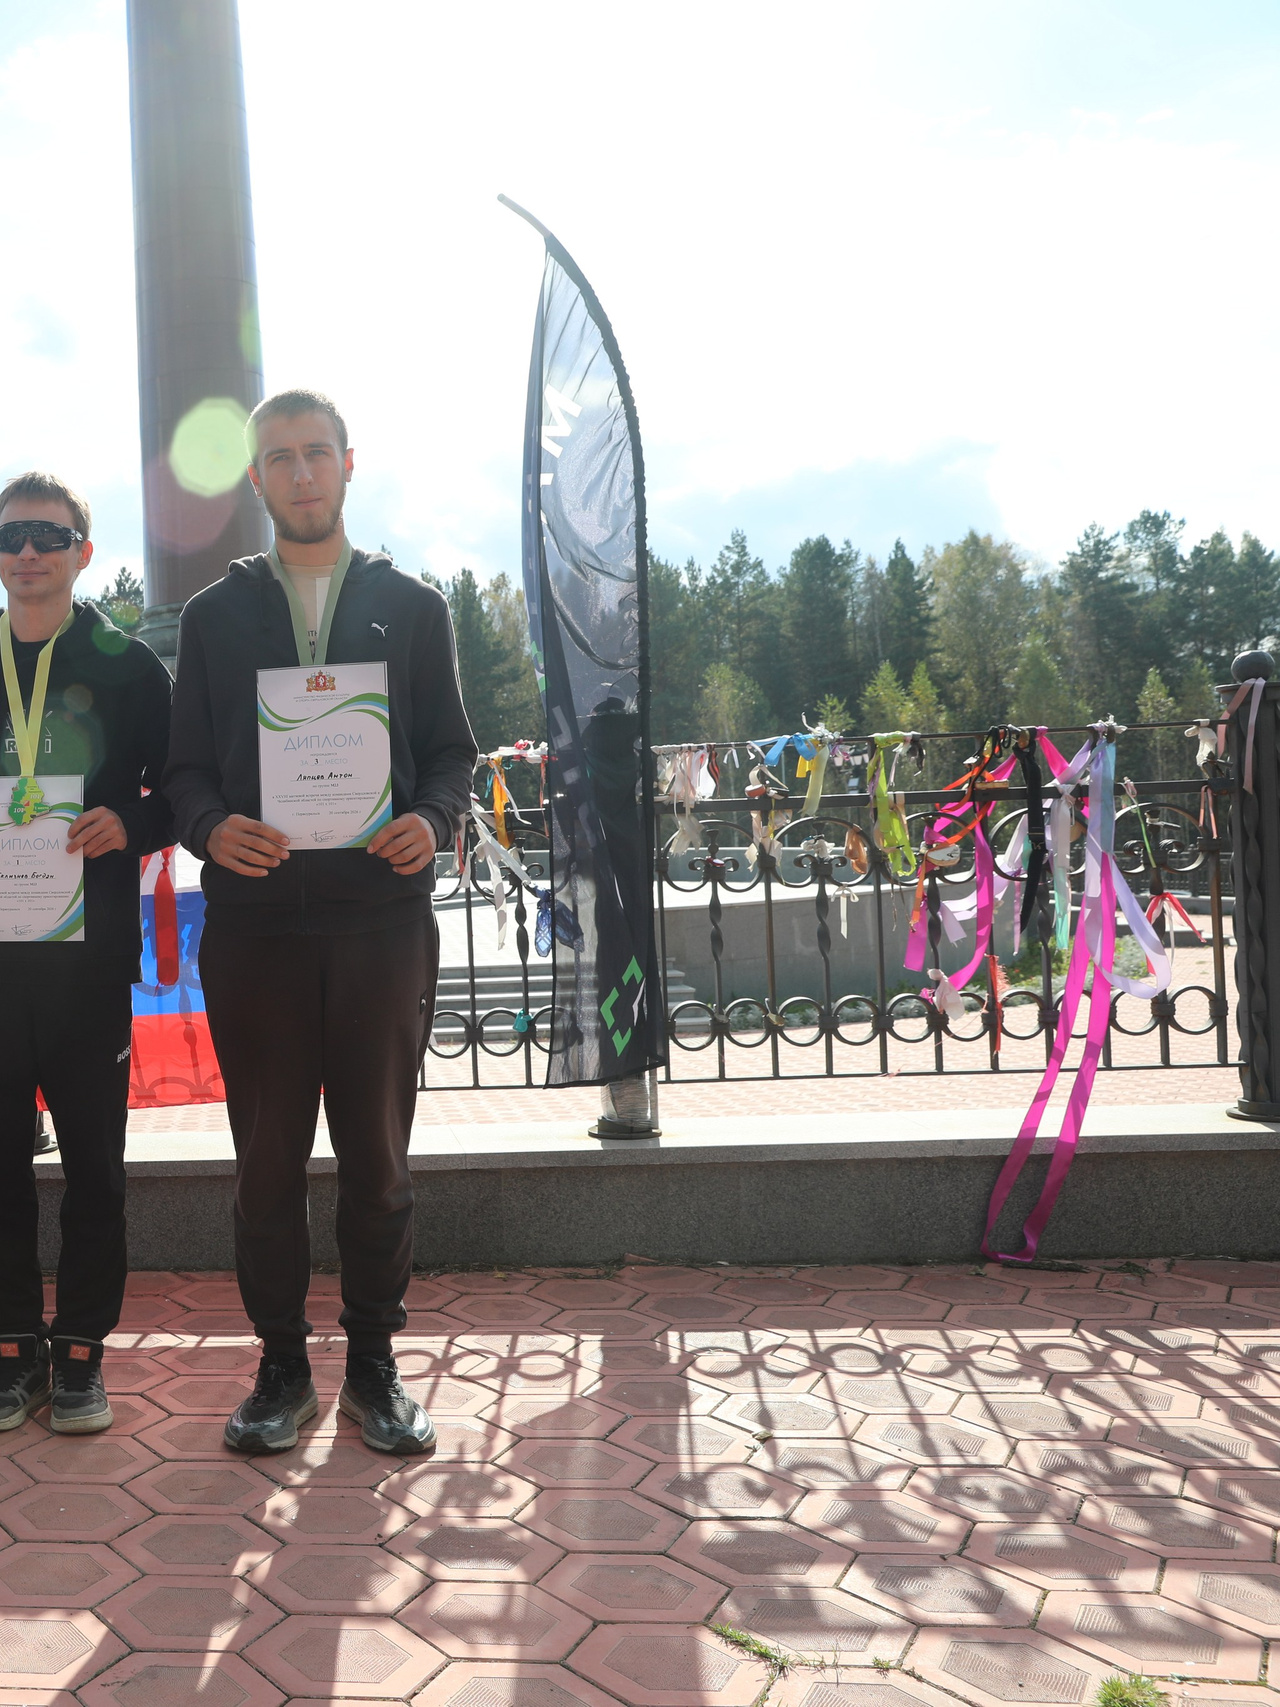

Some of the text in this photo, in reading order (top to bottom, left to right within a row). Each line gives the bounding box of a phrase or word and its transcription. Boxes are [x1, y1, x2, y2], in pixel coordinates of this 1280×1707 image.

[284, 733, 363, 751] ДИПЛОМ
[324, 757, 348, 765] МЕСТО
[327, 771, 353, 780] Антон
[116, 1044, 131, 1064] BOSS
